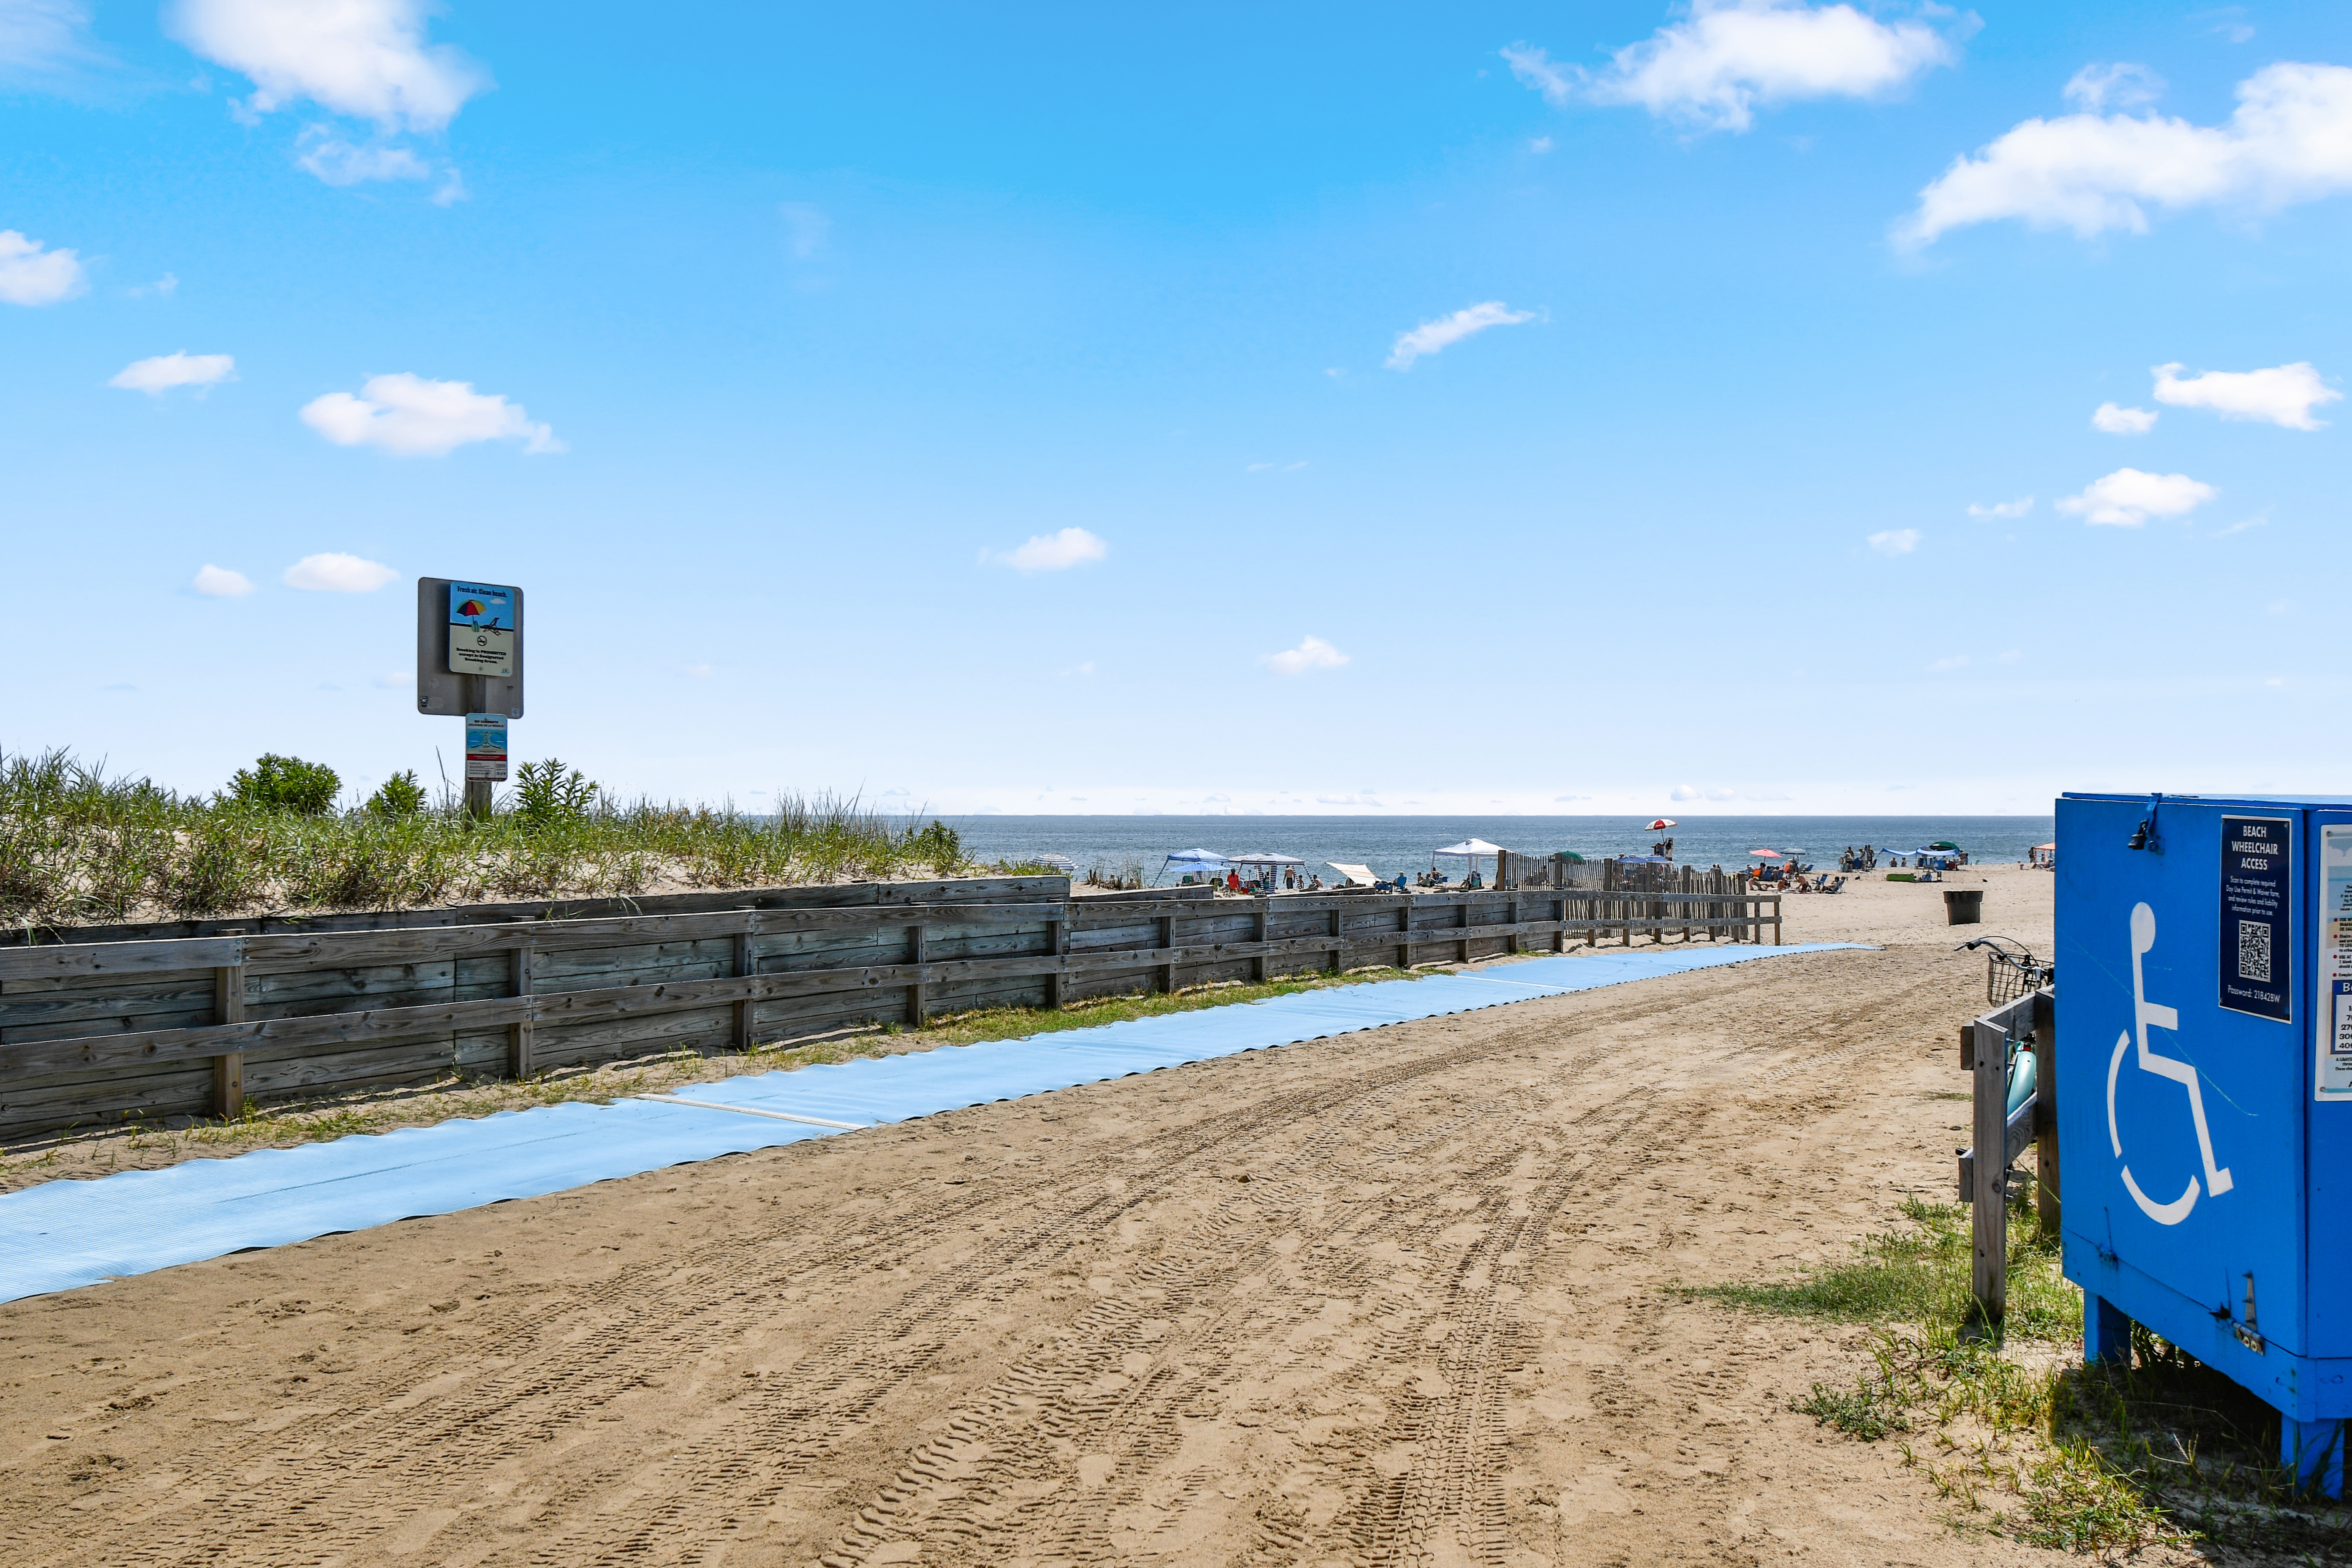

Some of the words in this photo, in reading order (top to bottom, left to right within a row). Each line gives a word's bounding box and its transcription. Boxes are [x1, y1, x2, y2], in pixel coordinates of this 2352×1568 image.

[2243, 825, 2266, 838] BEACH
[2232, 841, 2278, 855] WHEELCHAIR
[2241, 858, 2268, 870] ACCESS
[2244, 878, 2260, 886] complete
[2270, 889, 2280, 898] form,
[2232, 904, 2251, 912] information
[2265, 898, 2278, 908] liability
[2228, 985, 2252, 997] Password:
[2254, 990, 2280, 1003] 21842BW
